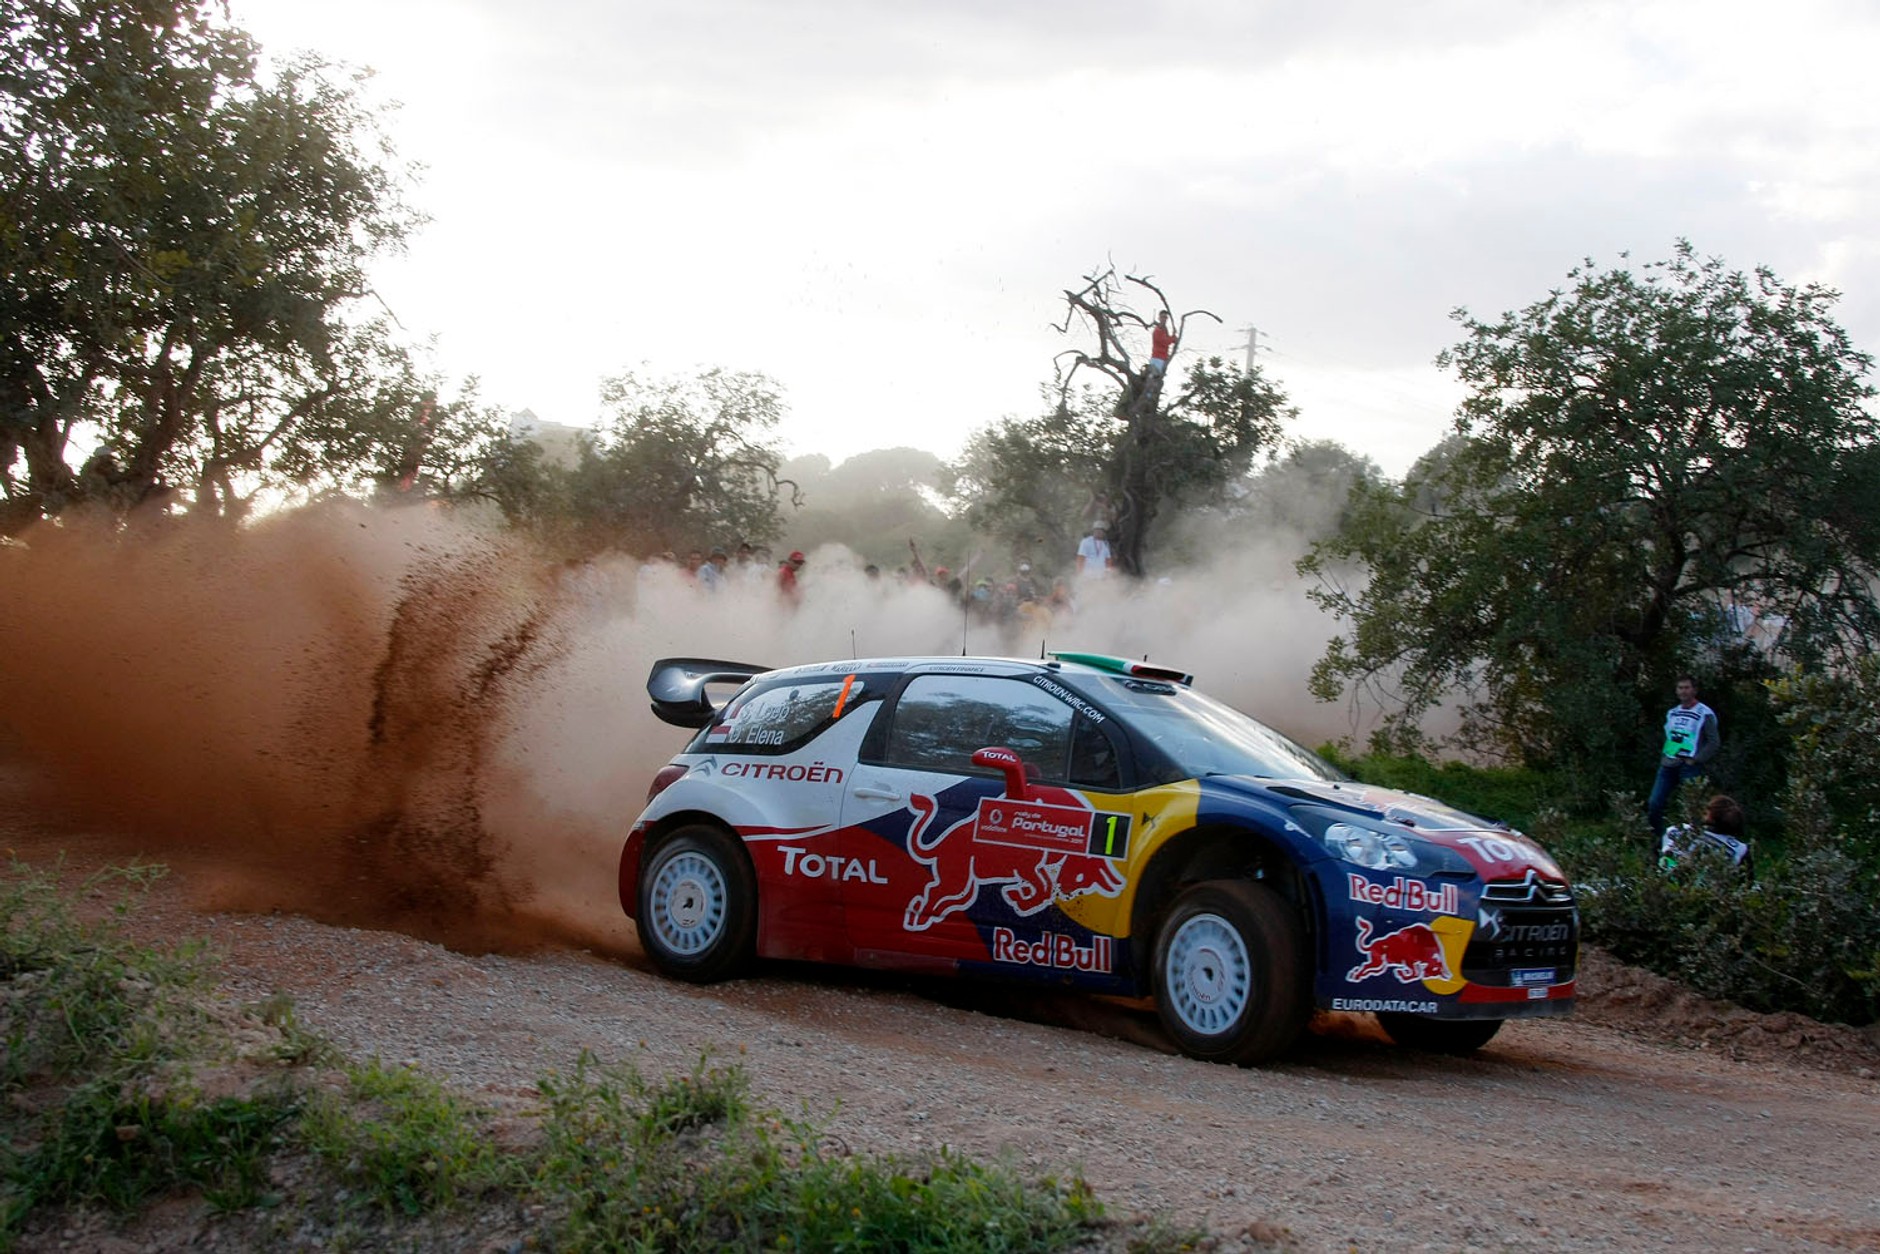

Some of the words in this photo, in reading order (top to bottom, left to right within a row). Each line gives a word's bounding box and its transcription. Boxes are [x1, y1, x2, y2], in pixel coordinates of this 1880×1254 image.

[832, 673, 857, 717] 1
[1033, 675, 1106, 723] CITROEN-WRC.COM
[745, 725, 785, 745] Elena
[982, 751, 1017, 762] TOTAL
[1011, 817, 1086, 838] Portugal
[1106, 816, 1118, 855] 1
[777, 845, 889, 884] TOTAL
[1347, 872, 1404, 909] Red
[1404, 879, 1458, 915] Bull
[993, 926, 1052, 967] Red
[1053, 933, 1112, 974] Bull
[1332, 998, 1438, 1013] EURODATACAR
